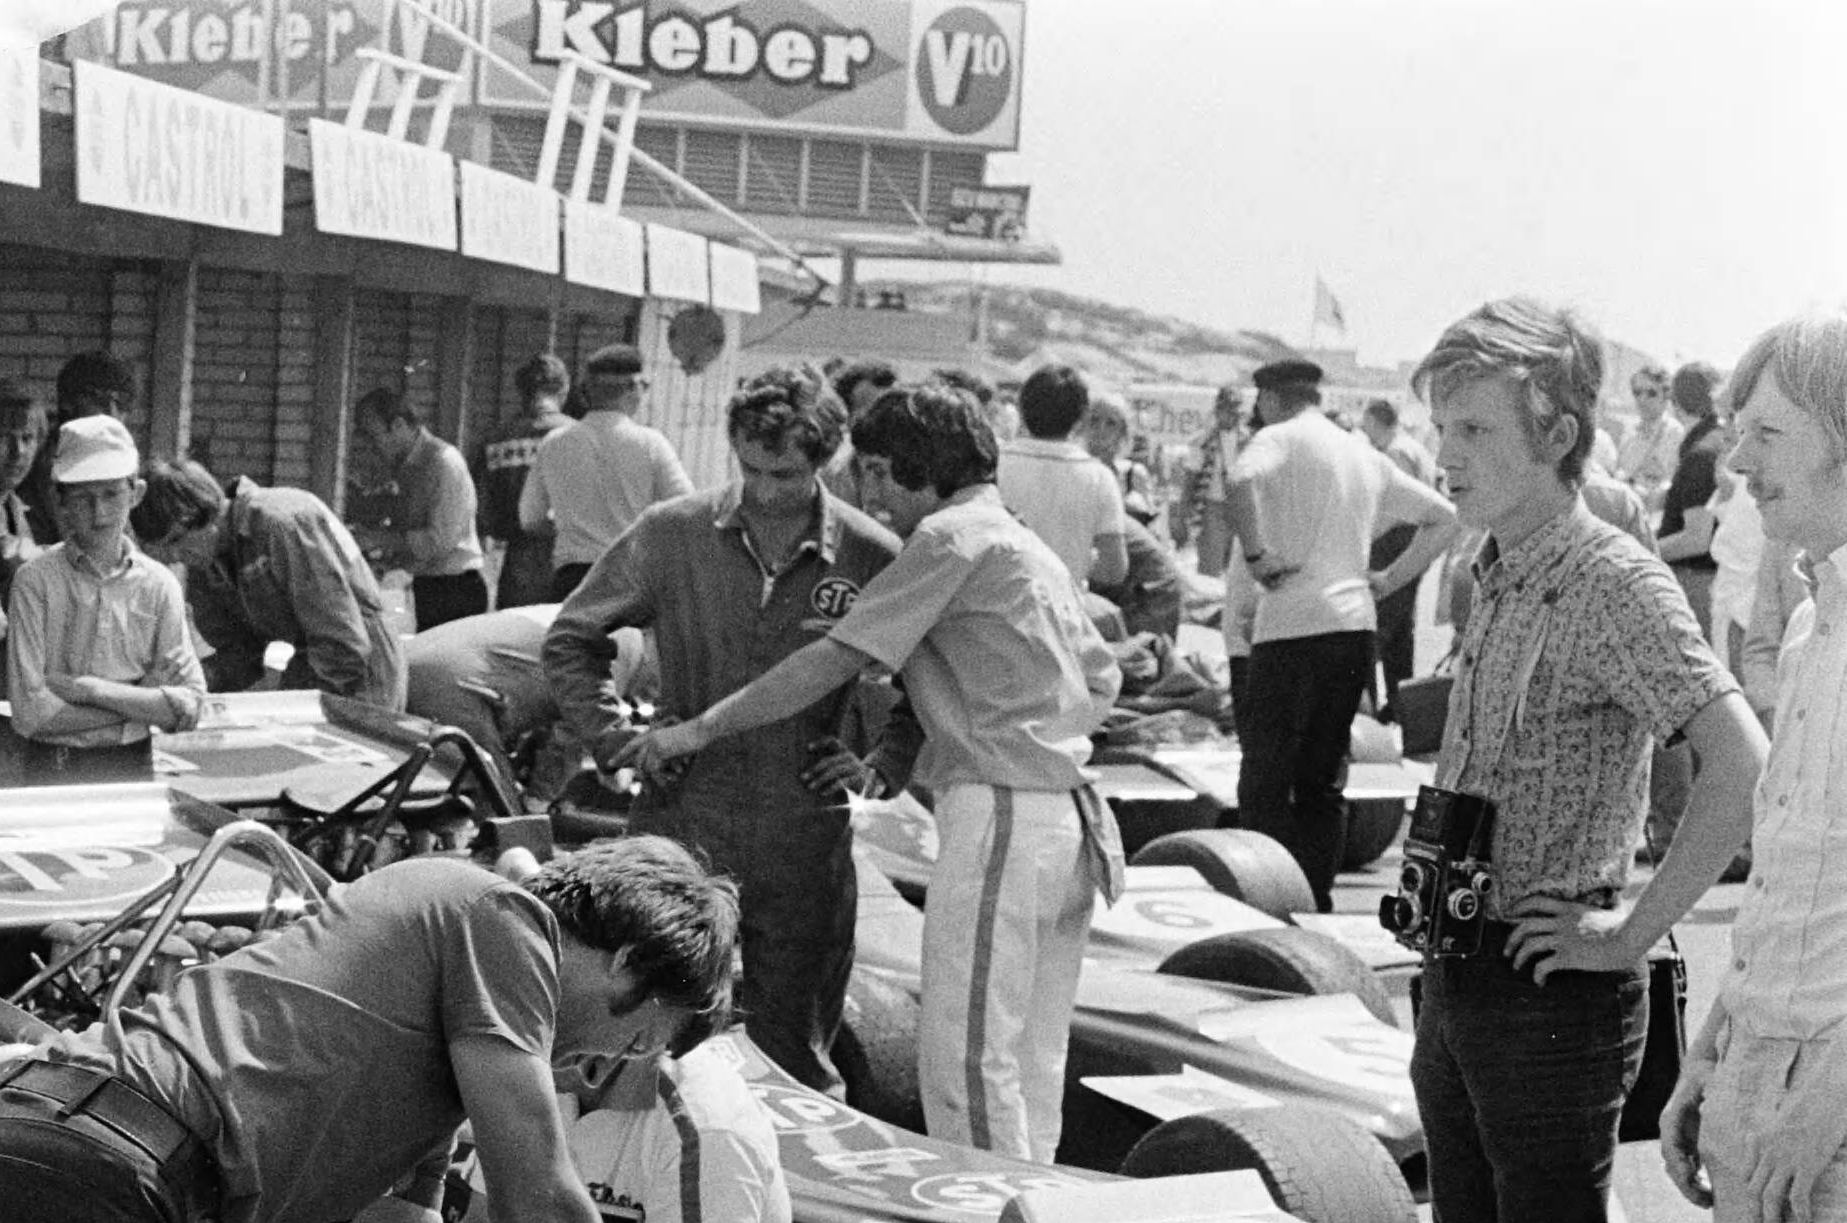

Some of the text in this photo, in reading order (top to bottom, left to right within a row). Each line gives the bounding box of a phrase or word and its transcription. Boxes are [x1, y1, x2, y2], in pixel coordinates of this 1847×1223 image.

[116, 6, 353, 67] Kleber
[536, 0, 872, 88] Kleber
[926, 28, 1008, 108] V10
